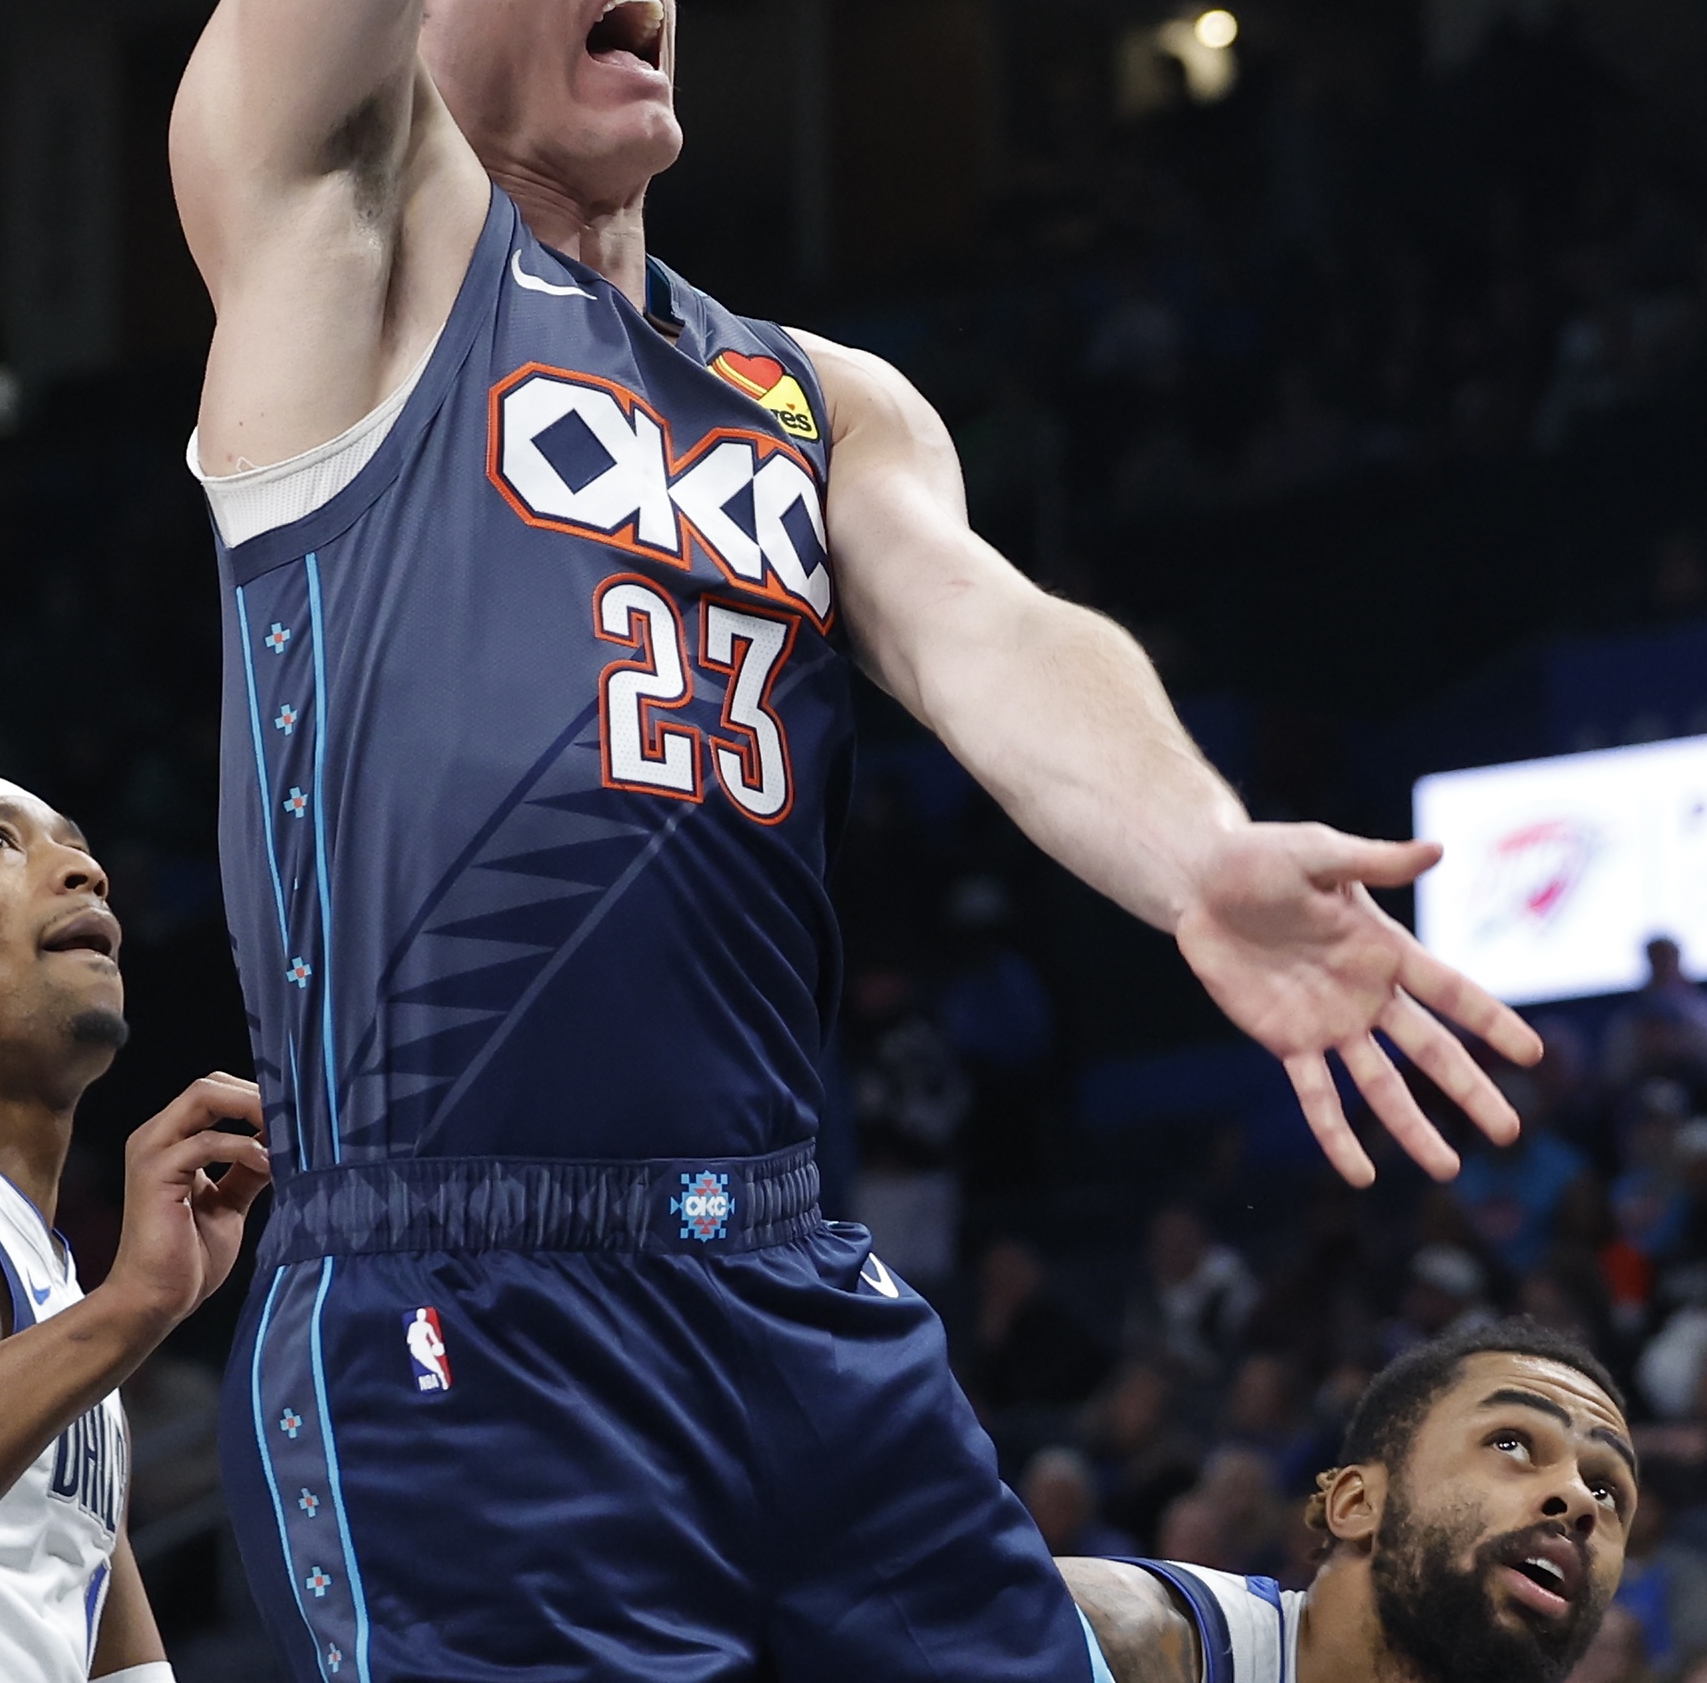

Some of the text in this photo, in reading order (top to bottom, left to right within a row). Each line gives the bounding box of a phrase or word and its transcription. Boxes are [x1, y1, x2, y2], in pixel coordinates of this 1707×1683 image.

[490, 365, 832, 630] OKC
[595, 574, 793, 825] 23
[685, 1195, 726, 1216] OKC
